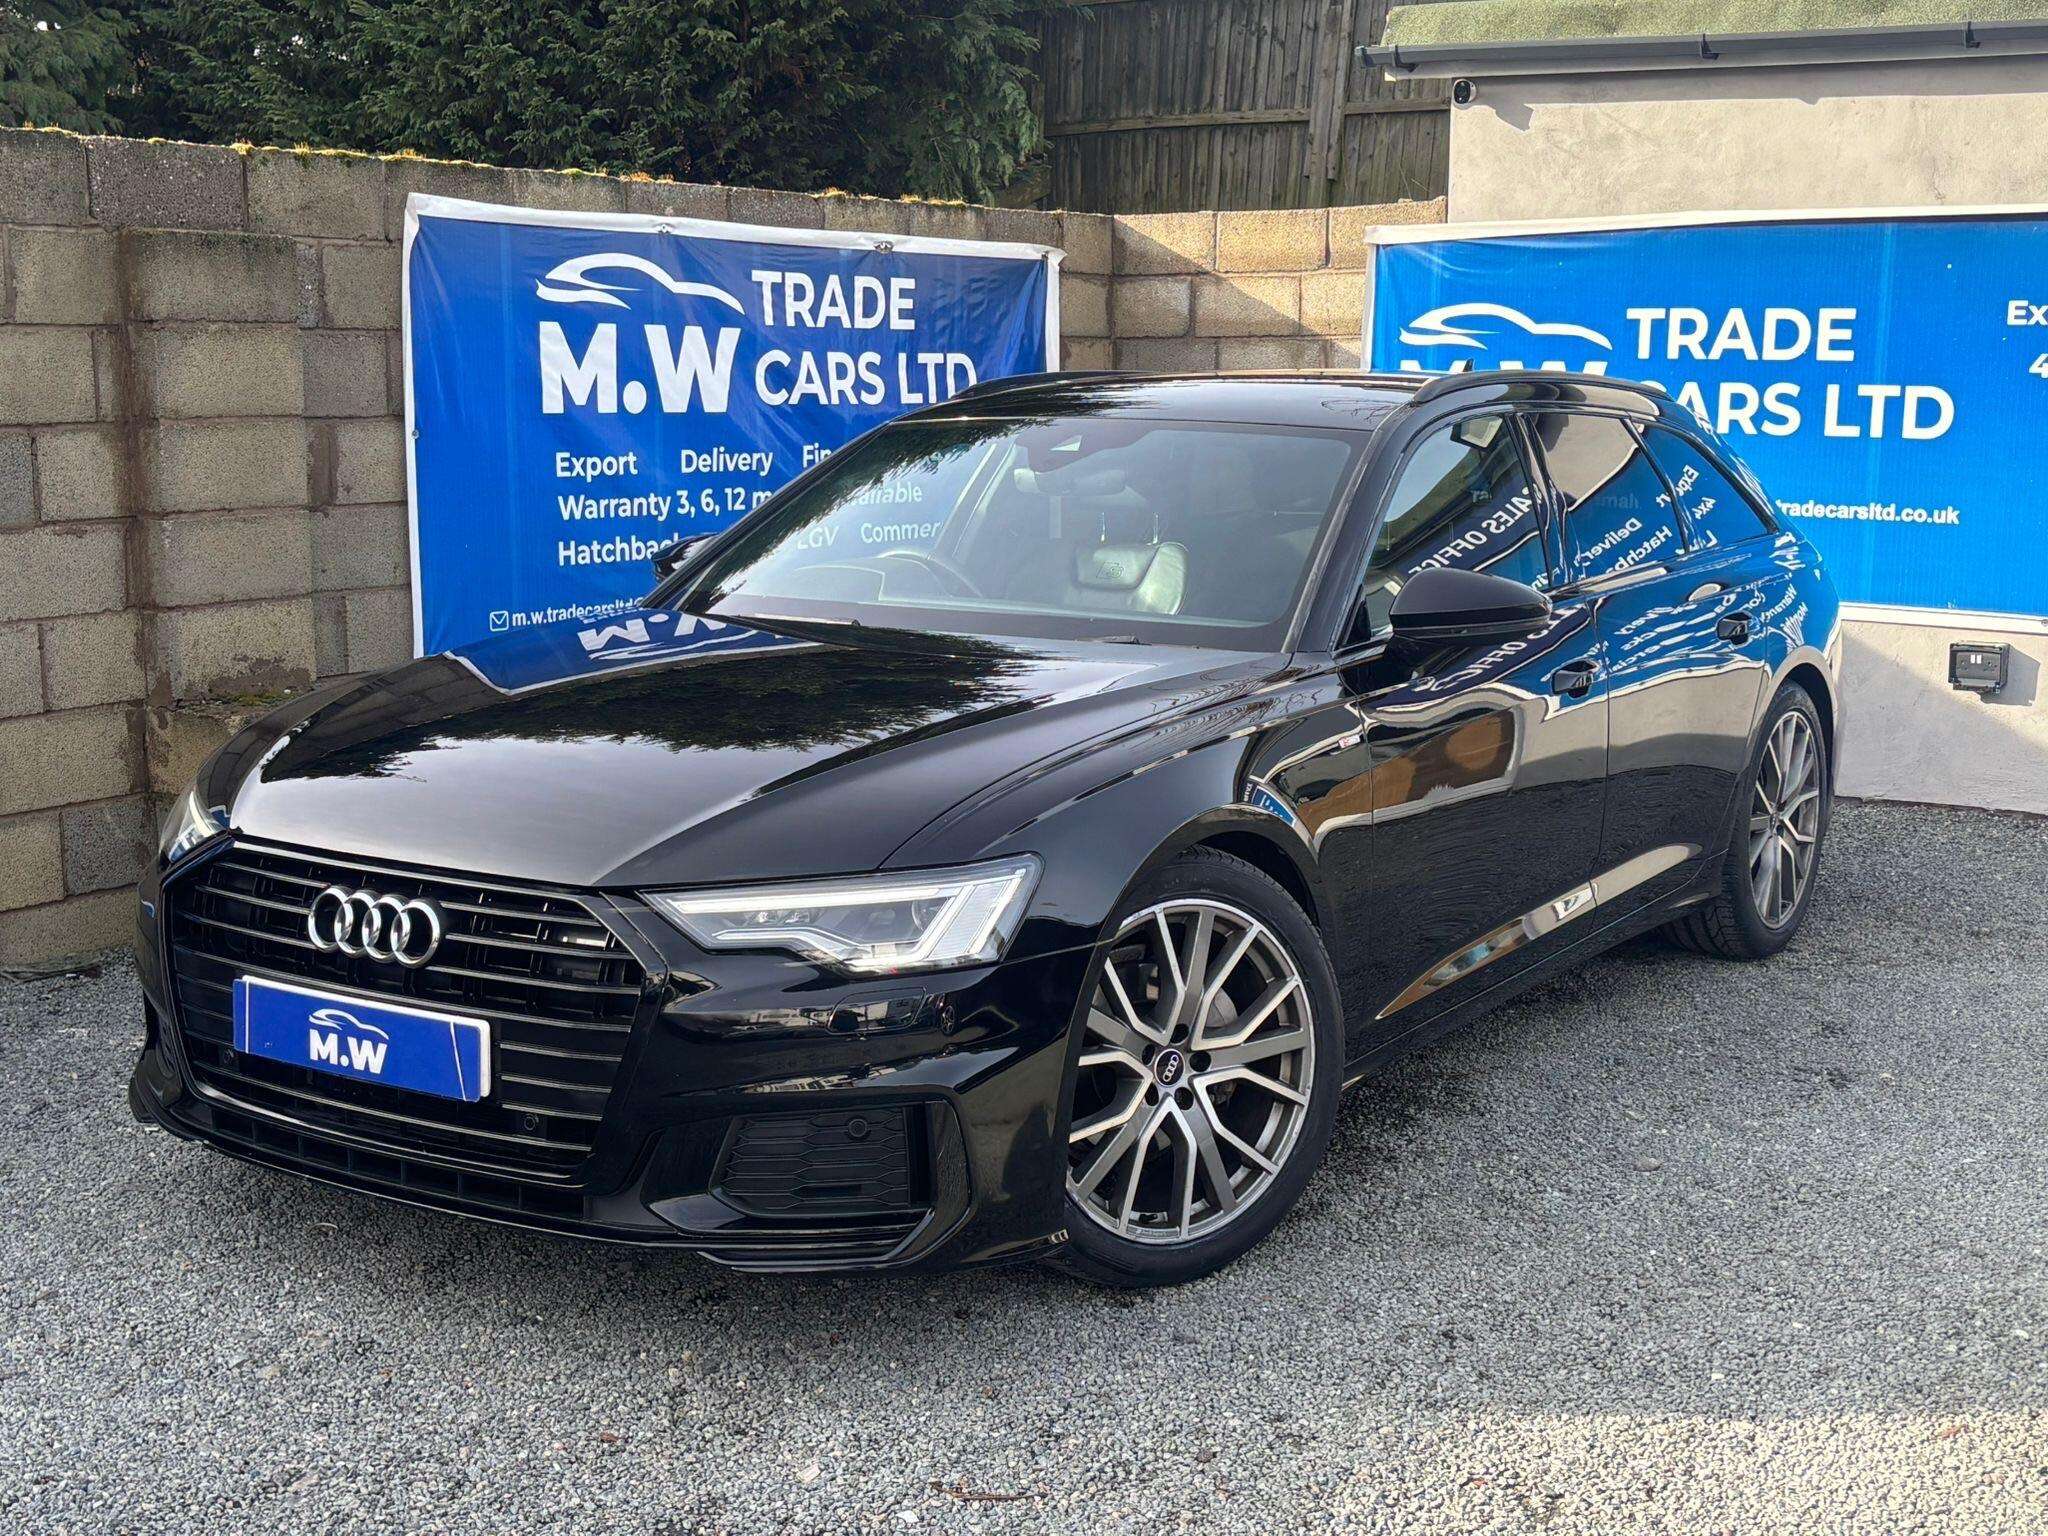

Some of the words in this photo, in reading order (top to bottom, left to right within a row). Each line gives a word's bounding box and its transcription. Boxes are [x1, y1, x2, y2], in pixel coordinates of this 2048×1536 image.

[751, 270, 915, 330] TRADE
[2006, 299, 2048, 326] Ex
[1626, 307, 1857, 362] TRADE
[539, 321, 741, 415] M.W
[755, 349, 886, 406] CARS
[898, 352, 978, 404] LTD
[1641, 380, 1801, 436] ARS
[1823, 384, 1955, 440] LTD
[555, 451, 639, 483] Export
[681, 446, 773, 477] Delivery
[557, 493, 671, 522] Warranty
[676, 490, 696, 518] 3,
[700, 488, 720, 517] 6,
[724, 487, 746, 511] 12
[557, 533, 680, 566] Hatchba
[309, 1028, 388, 1075] M.W
